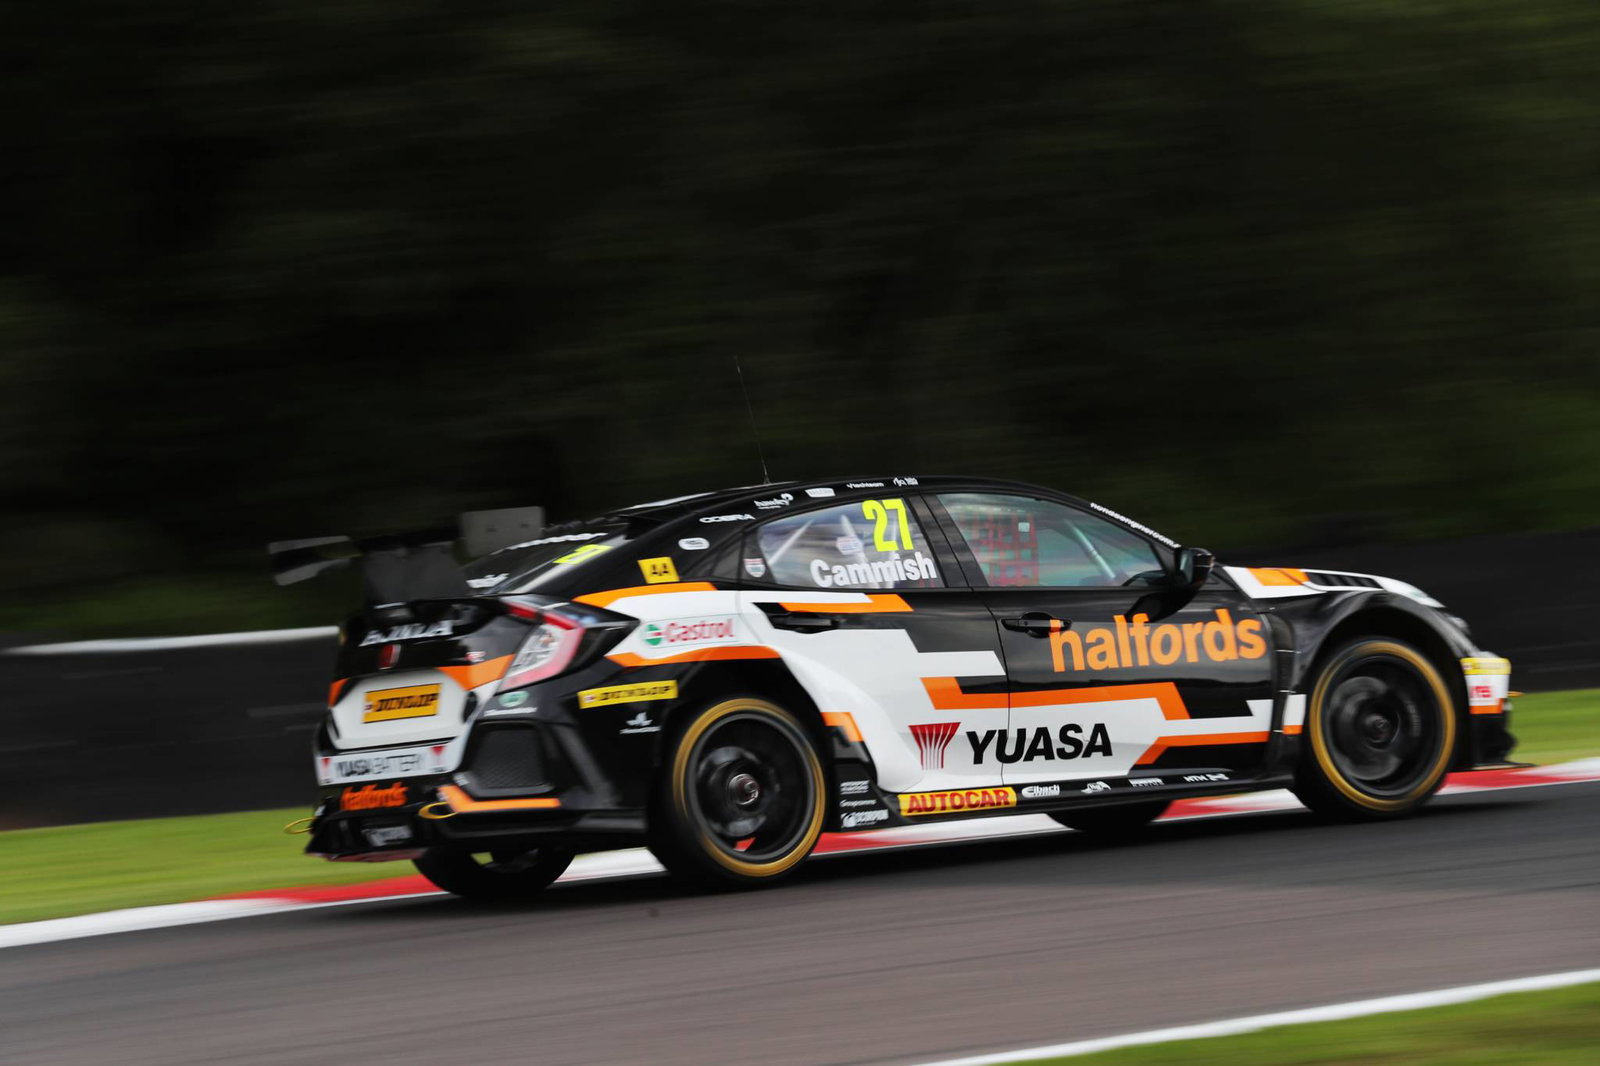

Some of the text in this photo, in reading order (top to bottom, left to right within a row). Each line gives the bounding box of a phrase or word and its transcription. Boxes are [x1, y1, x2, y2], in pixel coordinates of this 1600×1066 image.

[862, 498, 913, 551] 27
[810, 552, 936, 588] Cammish
[664, 618, 735, 643] Castrol
[1049, 608, 1266, 672] halfords
[375, 693, 440, 712] DUNLOP
[966, 723, 1112, 765] YUASA
[908, 789, 1010, 813] AUTOCAR
